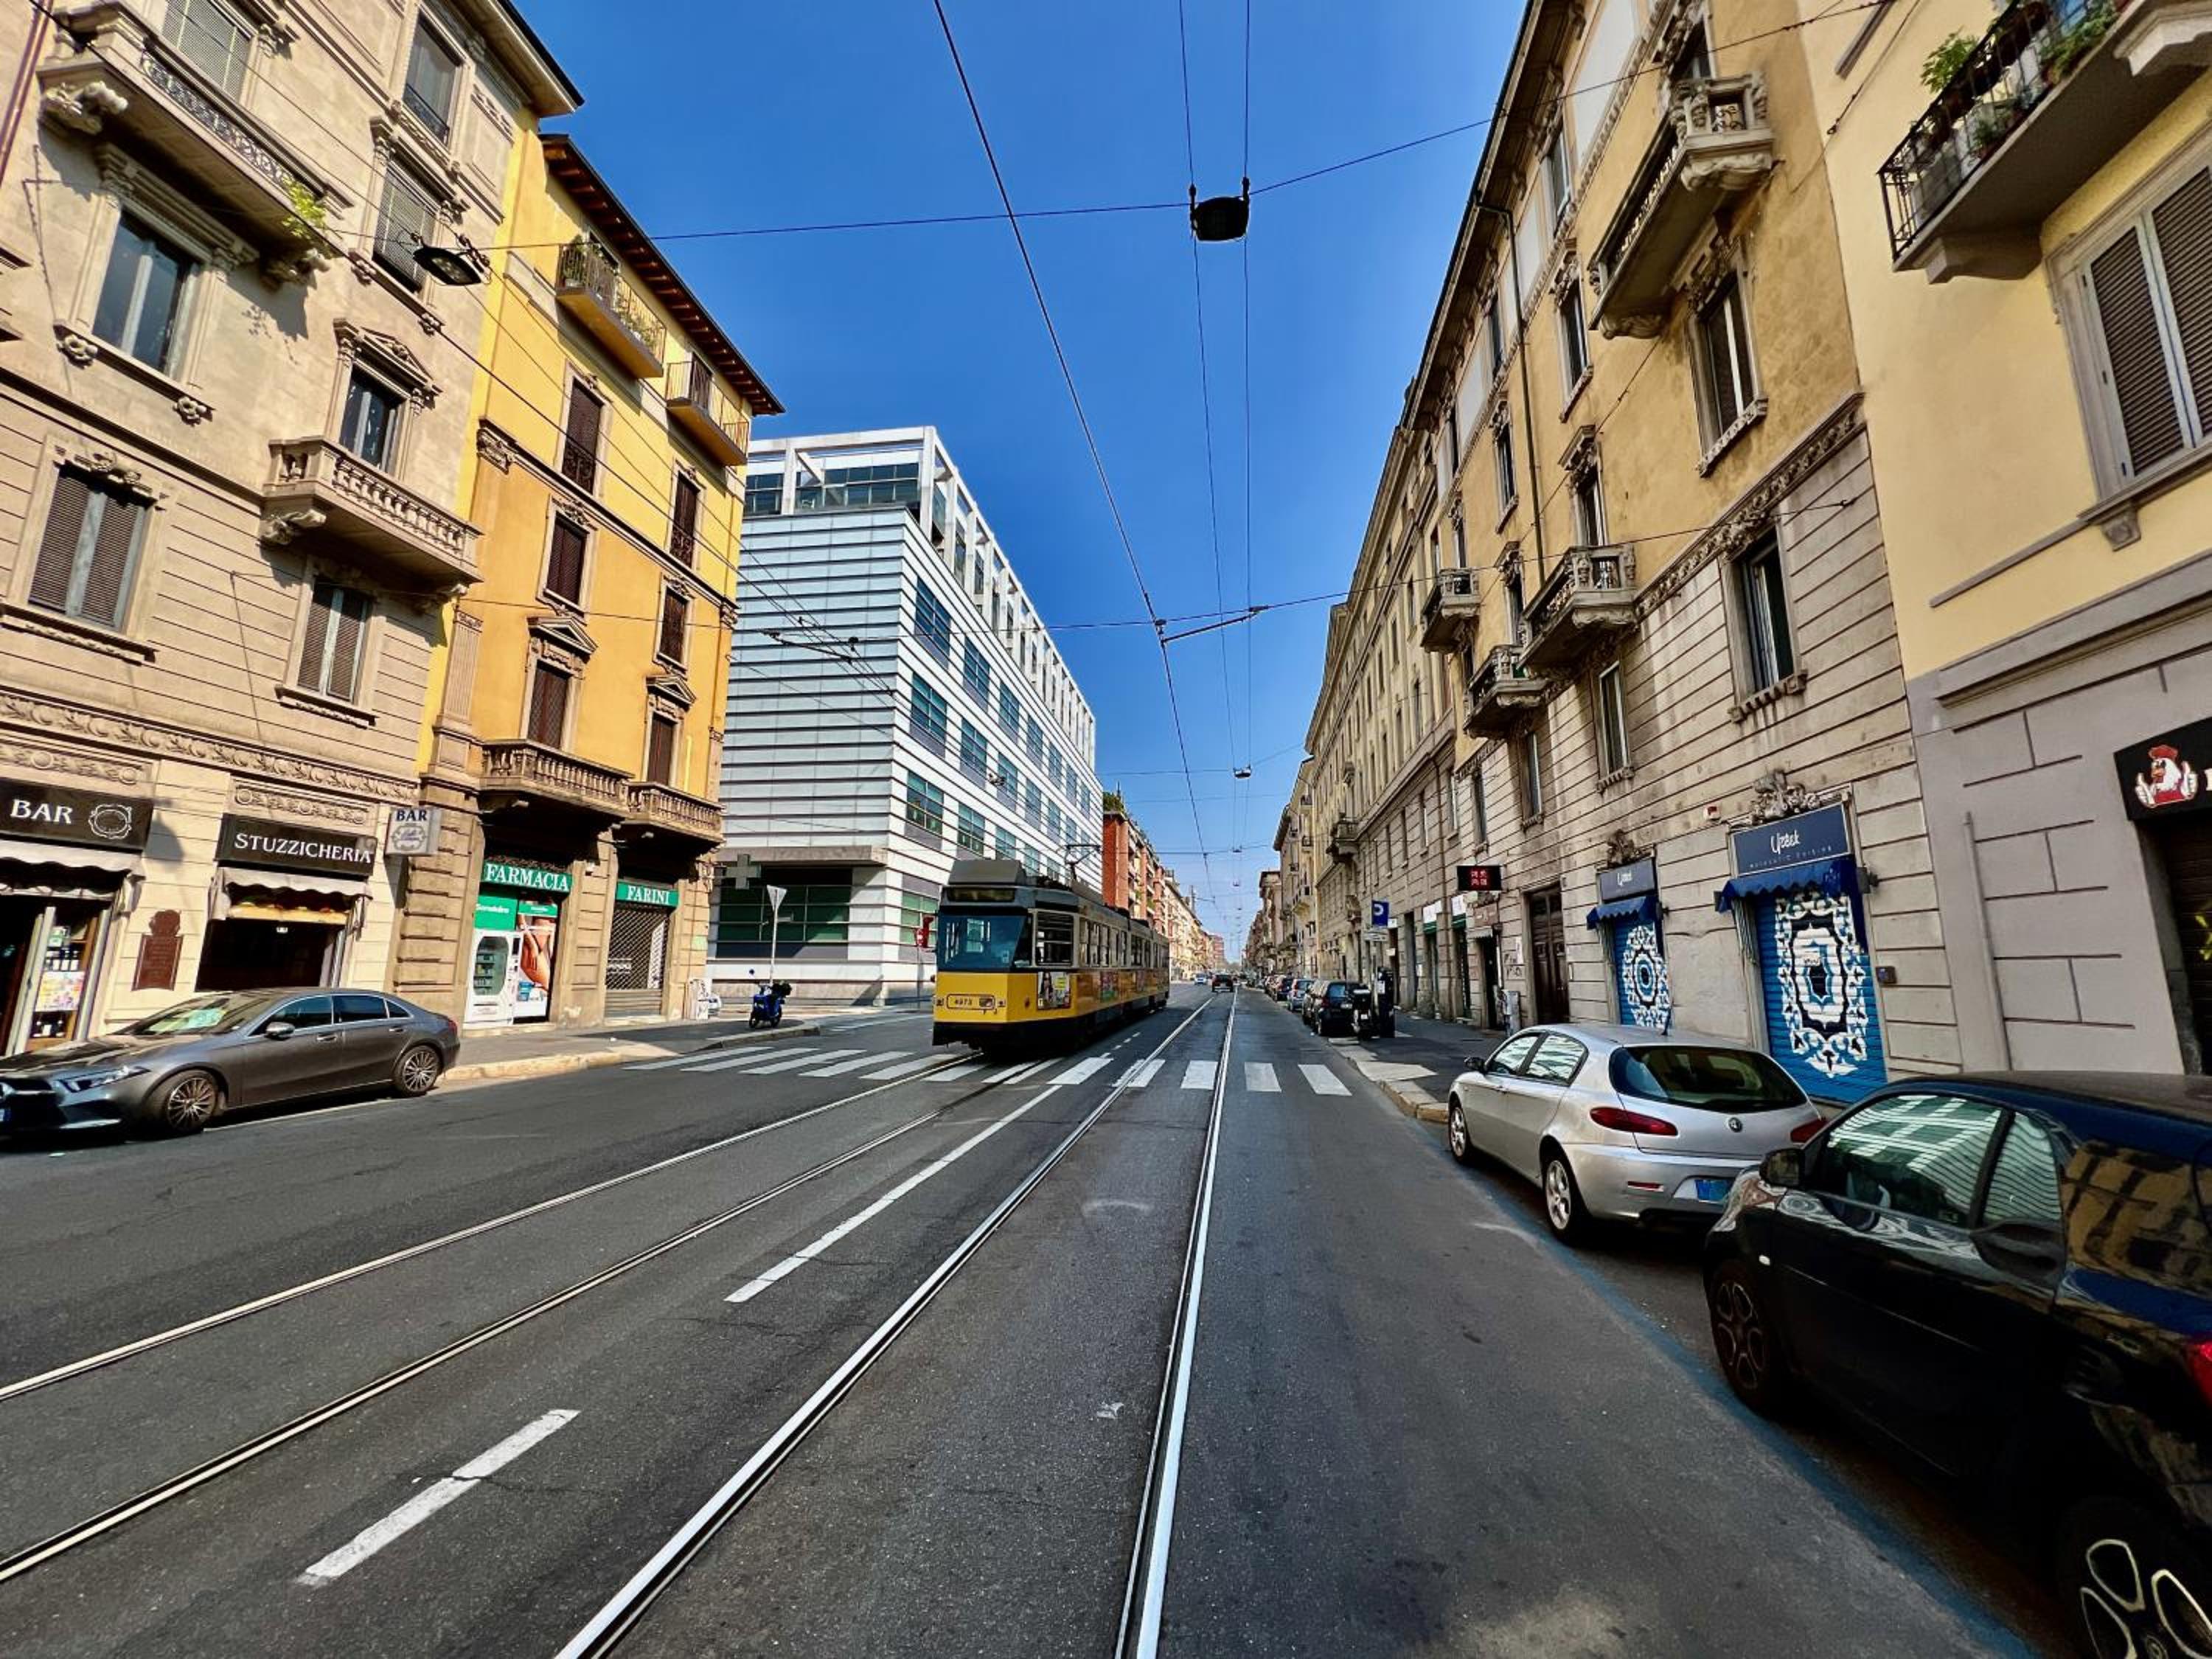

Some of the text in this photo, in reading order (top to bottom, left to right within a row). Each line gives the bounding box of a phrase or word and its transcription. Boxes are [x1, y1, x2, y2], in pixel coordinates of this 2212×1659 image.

[10, 799, 73, 824] BAR
[396, 809, 427, 821] BAR
[234, 833, 371, 863] STUZZICHERIA
[485, 863, 570, 892] FARMACIA
[627, 886, 670, 905] FARINI
